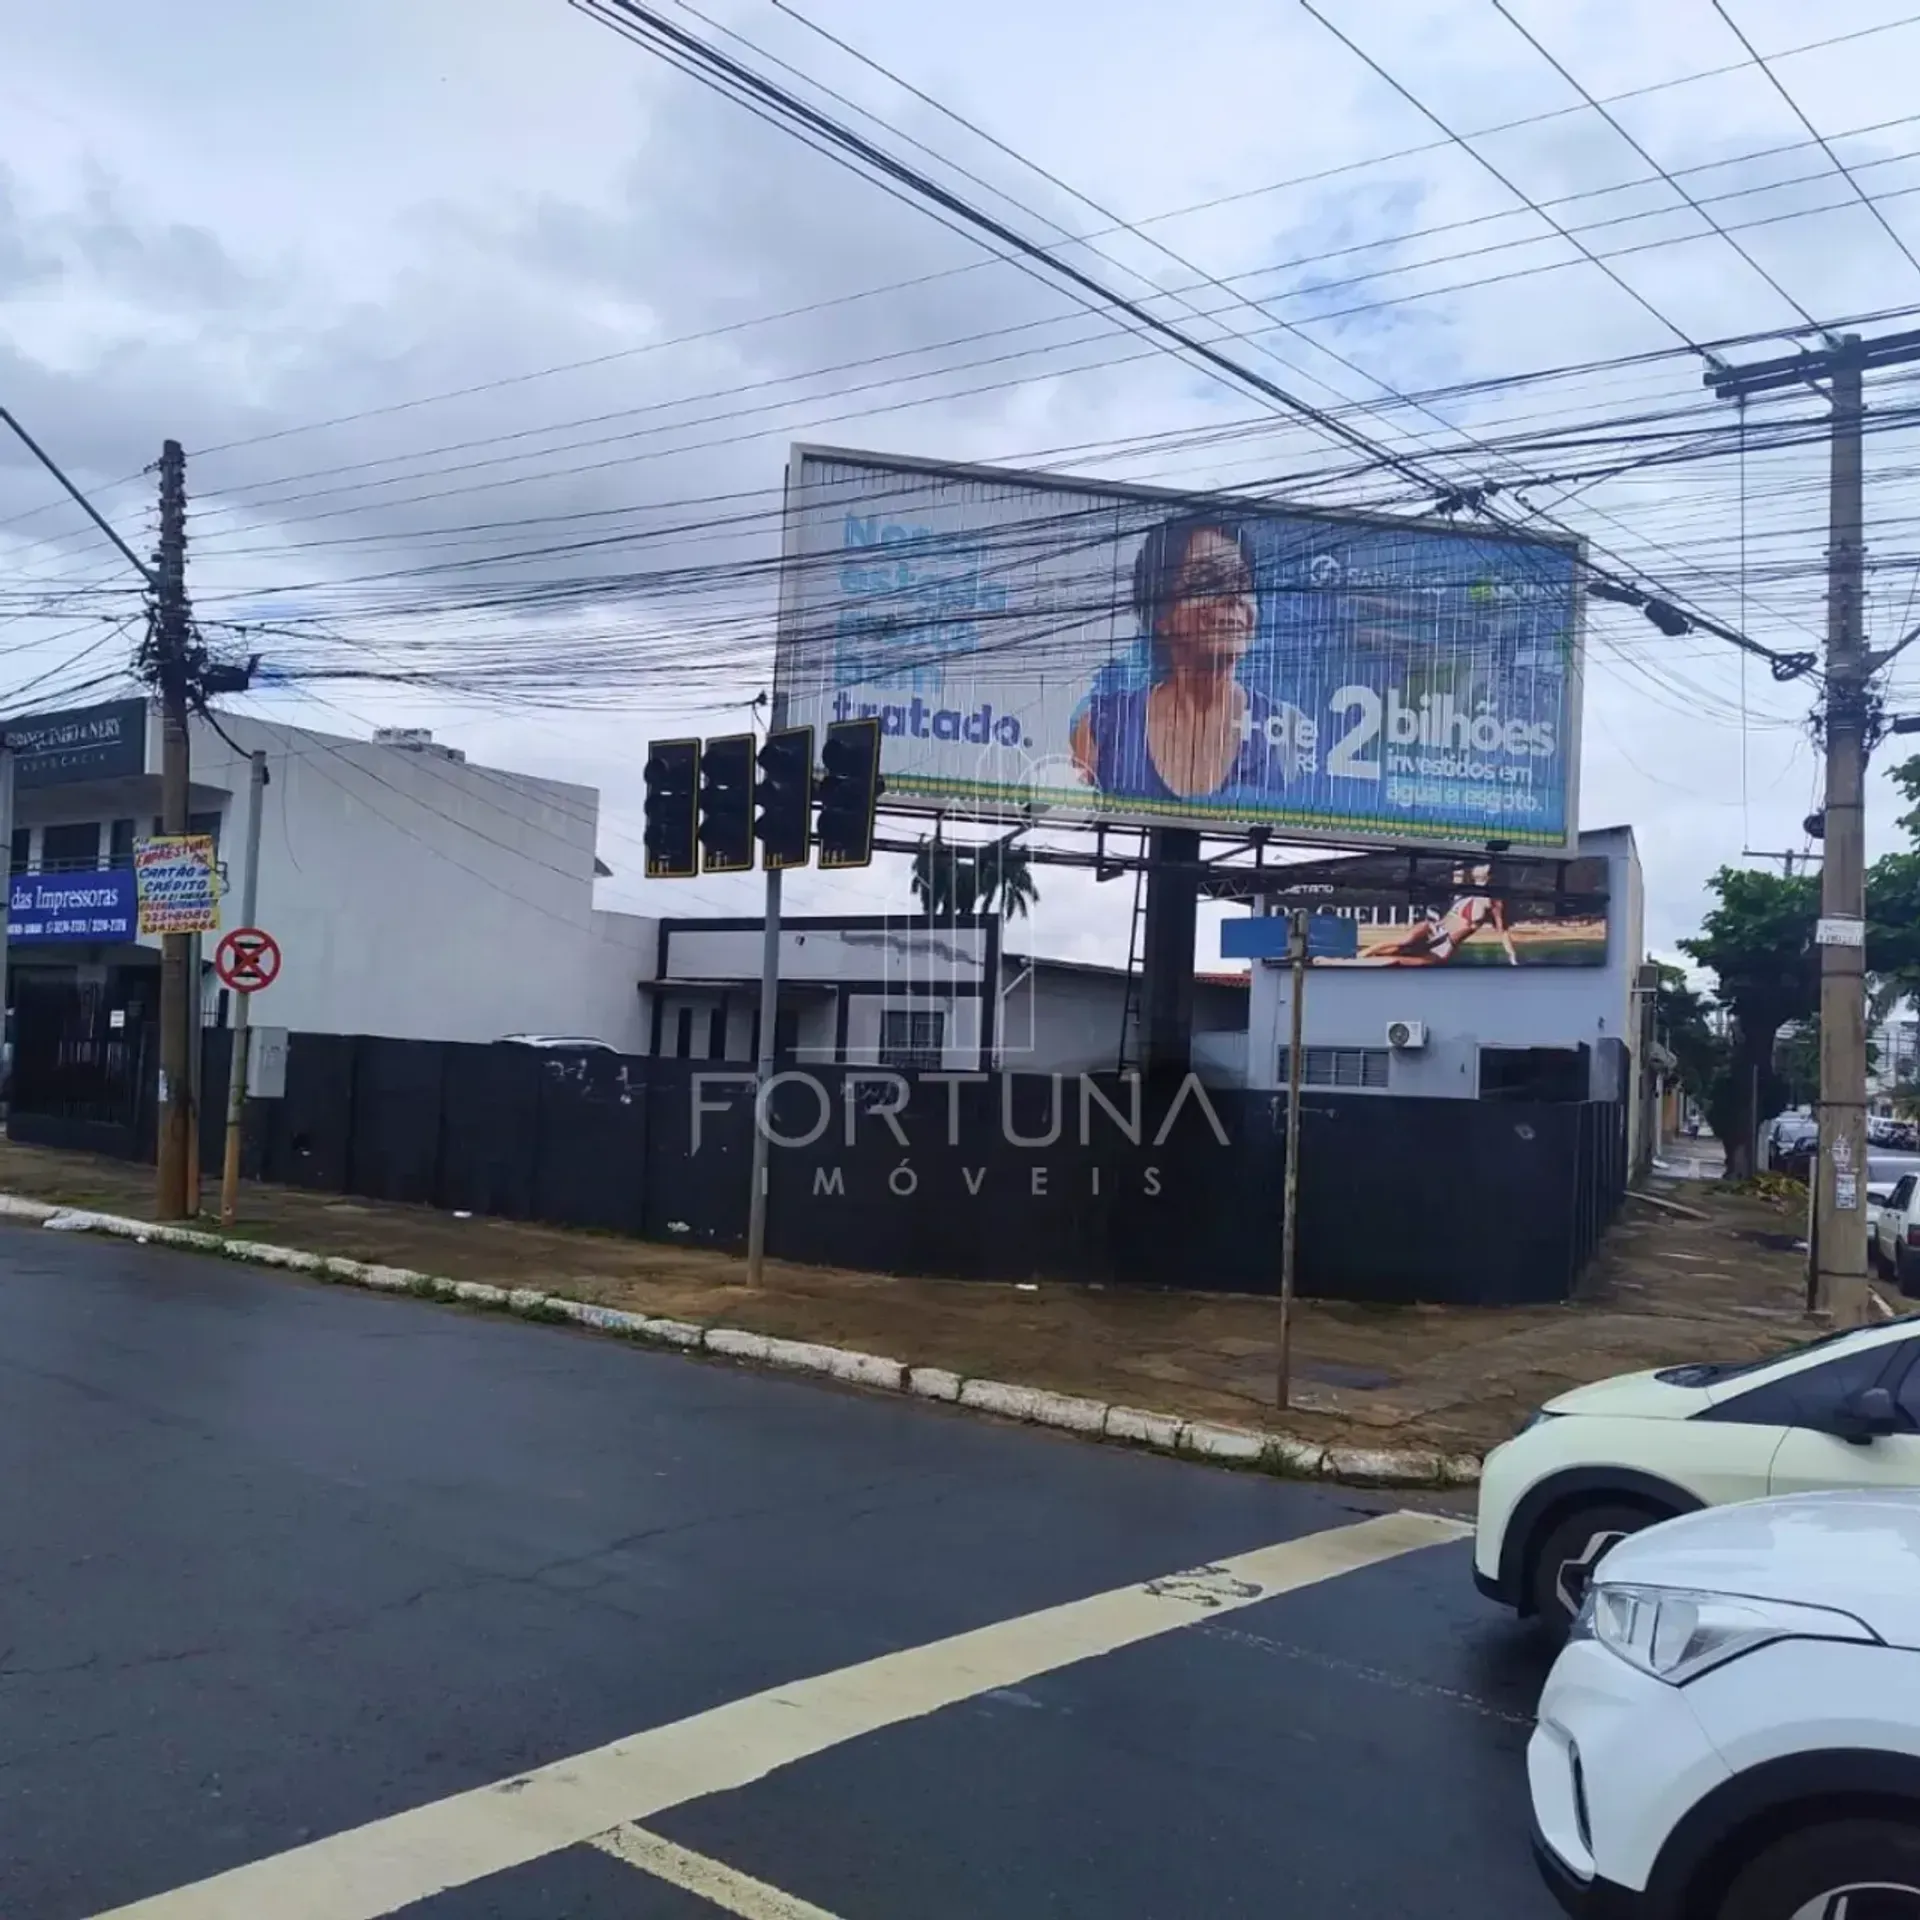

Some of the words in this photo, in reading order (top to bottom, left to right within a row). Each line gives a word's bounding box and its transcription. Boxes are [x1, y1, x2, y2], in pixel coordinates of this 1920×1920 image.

[833, 691, 1034, 748] tratado.
[1327, 684, 1382, 780] 2
[1387, 688, 1555, 757] bilhões
[1387, 748, 1496, 780] investidos
[1499, 764, 1533, 783] em
[11, 885, 33, 910] das
[35, 885, 119, 916] Impressoras
